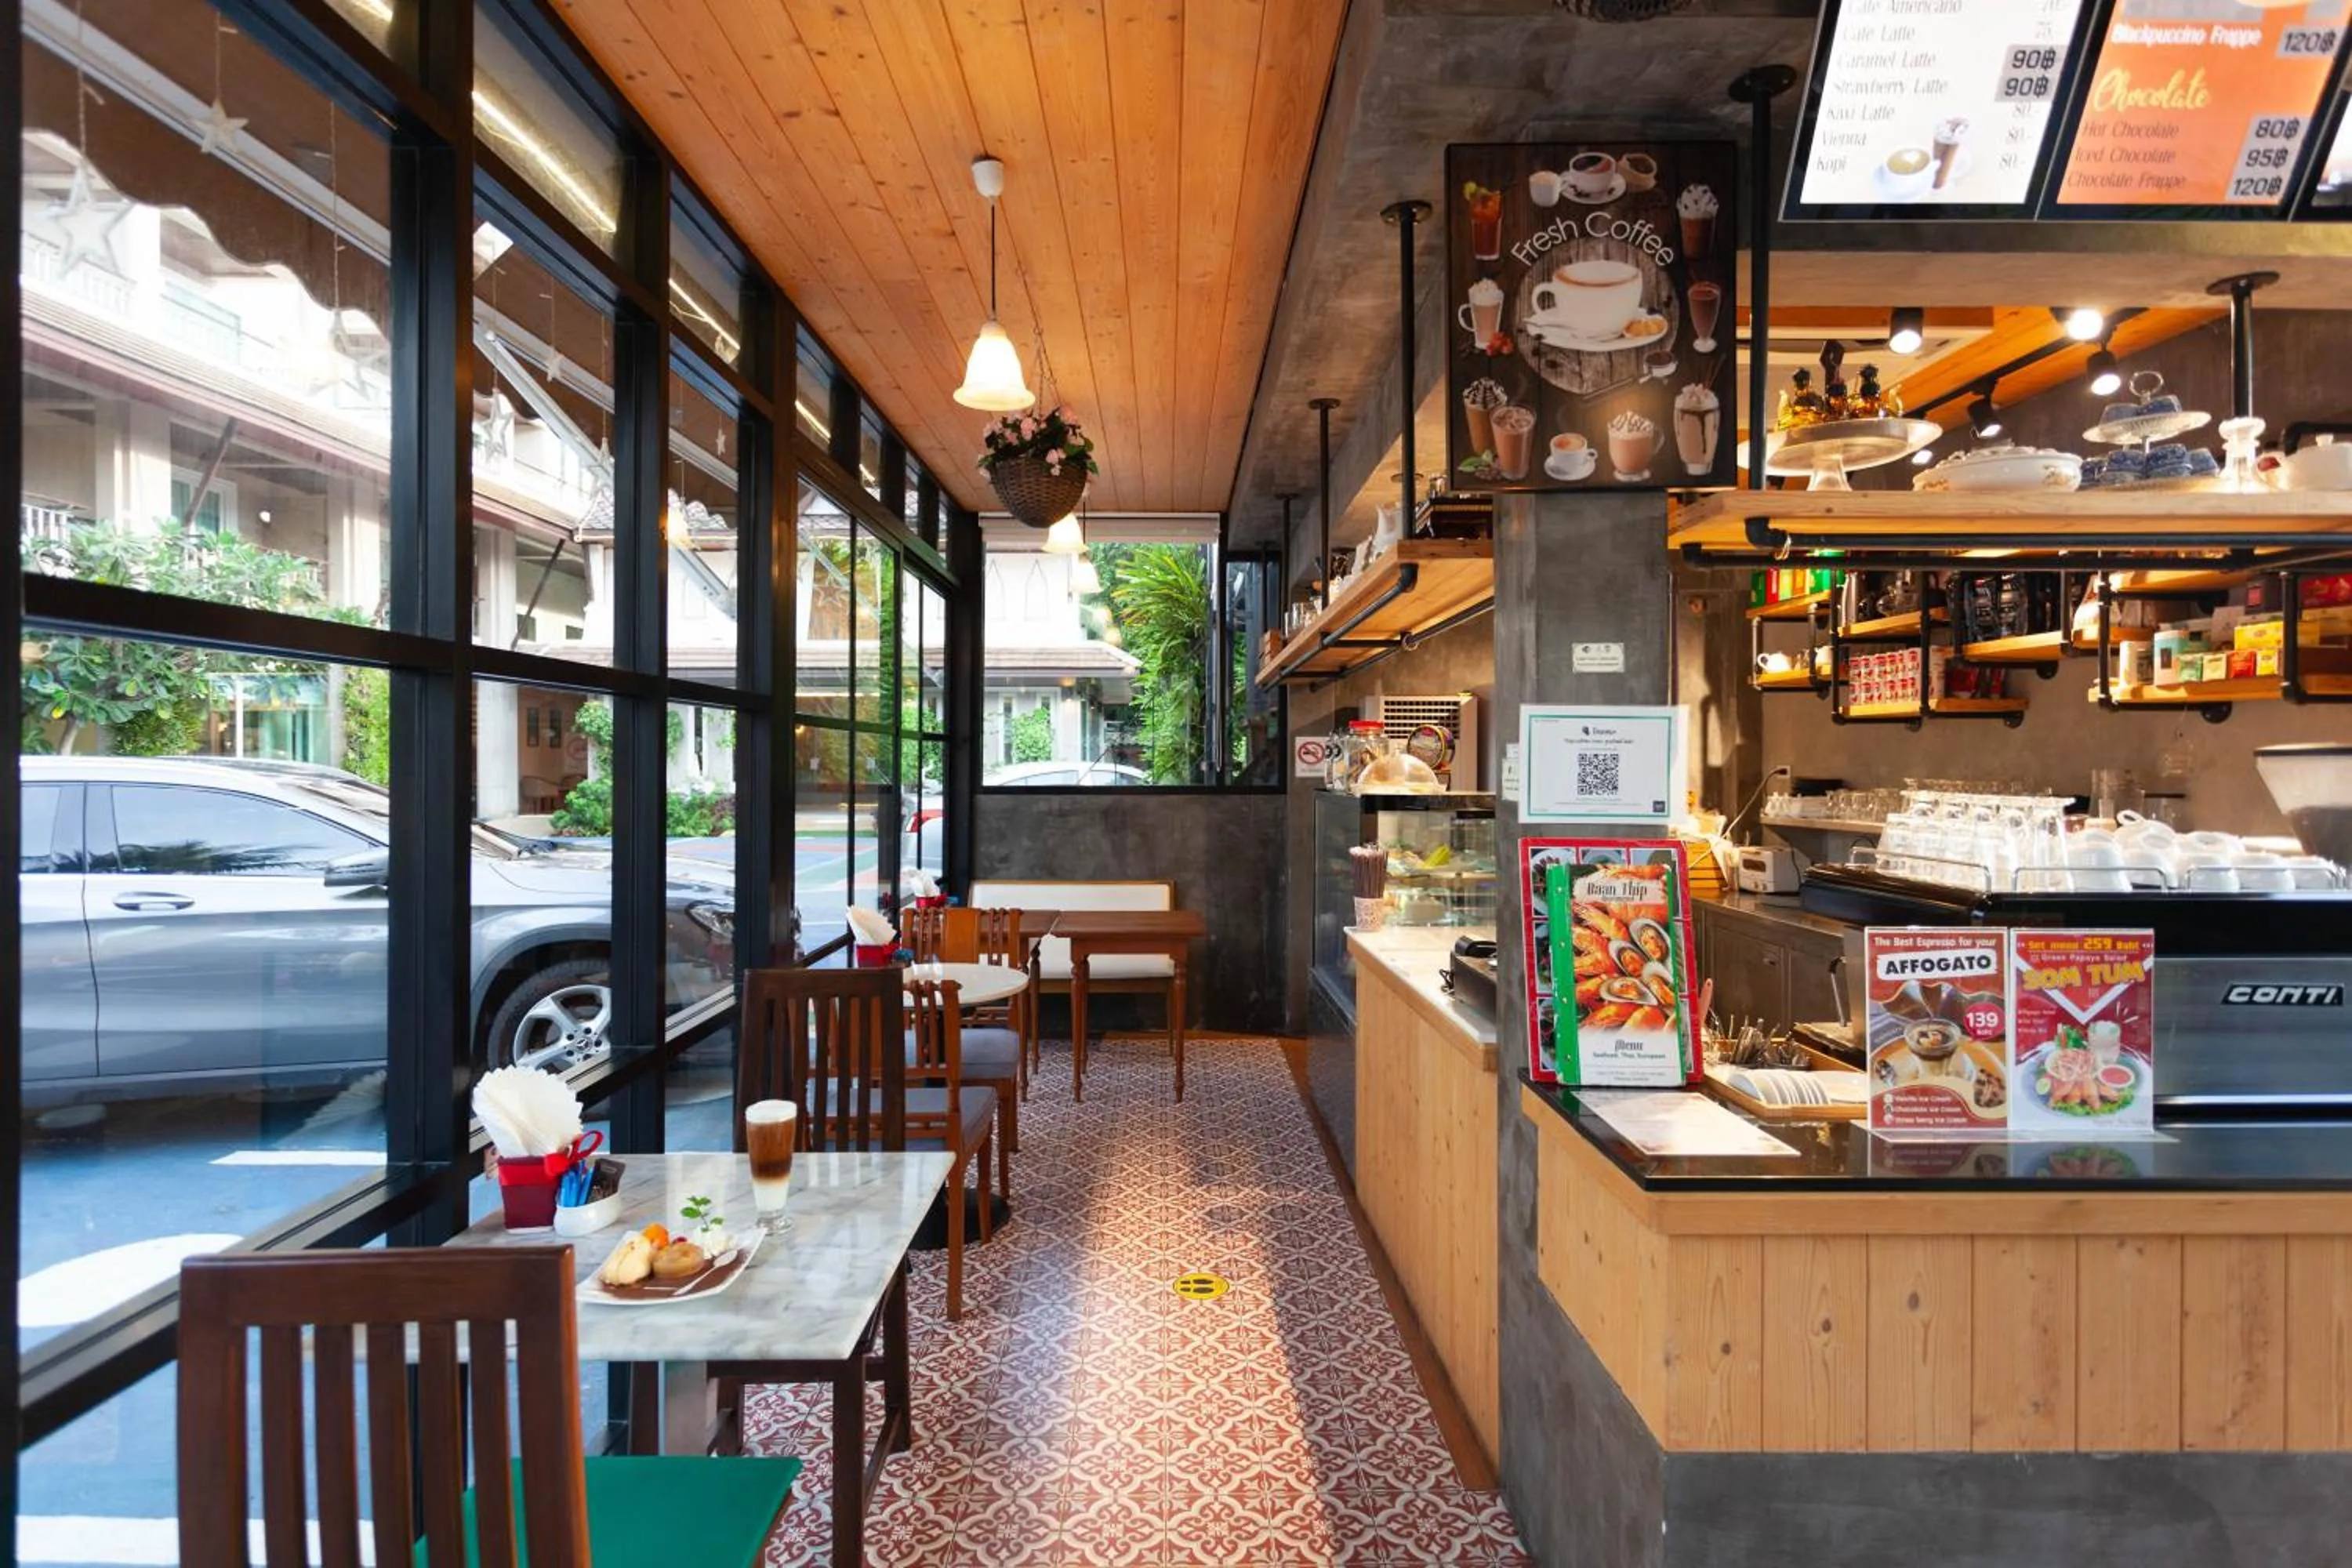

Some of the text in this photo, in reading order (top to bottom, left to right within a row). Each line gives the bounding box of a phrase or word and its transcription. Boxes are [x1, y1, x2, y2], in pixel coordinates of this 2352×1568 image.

[1882, 23, 1916, 42] Latte
[2210, 24, 2263, 49] Frappe
[1838, 51, 1895, 69] Caramel
[1900, 51, 1936, 68] Latte
[1833, 78, 1906, 96] Strawberry
[1913, 78, 1949, 95] Latte
[2092, 67, 2210, 111] Chocolate
[1861, 103, 1895, 121] Latte
[1821, 130, 1867, 147] Vienna
[2082, 120, 2107, 137] Hot
[2111, 119, 2180, 140] Chocolate
[1816, 155, 1849, 174] Kopi
[2075, 146, 2104, 163] Iced
[2109, 146, 2177, 165] Chocolate
[2067, 172, 2134, 190] Chocolate
[2138, 172, 2187, 194] Frappe
[1510, 211, 1675, 267] Fresh Coffee
[1874, 936, 1997, 949] The Best Espresso for your
[2082, 936, 2113, 951] 259
[1885, 954, 1992, 975] AFFOGATO
[2041, 953, 2067, 961] Green
[2069, 953, 2101, 963] Papaya
[2103, 953, 2128, 962] Salad
[2022, 960, 2147, 991] SOM TUM
[2227, 985, 2338, 1004] CONTI
[1965, 1011, 1999, 1029] 139
[1615, 1038, 1644, 1052] Menu
